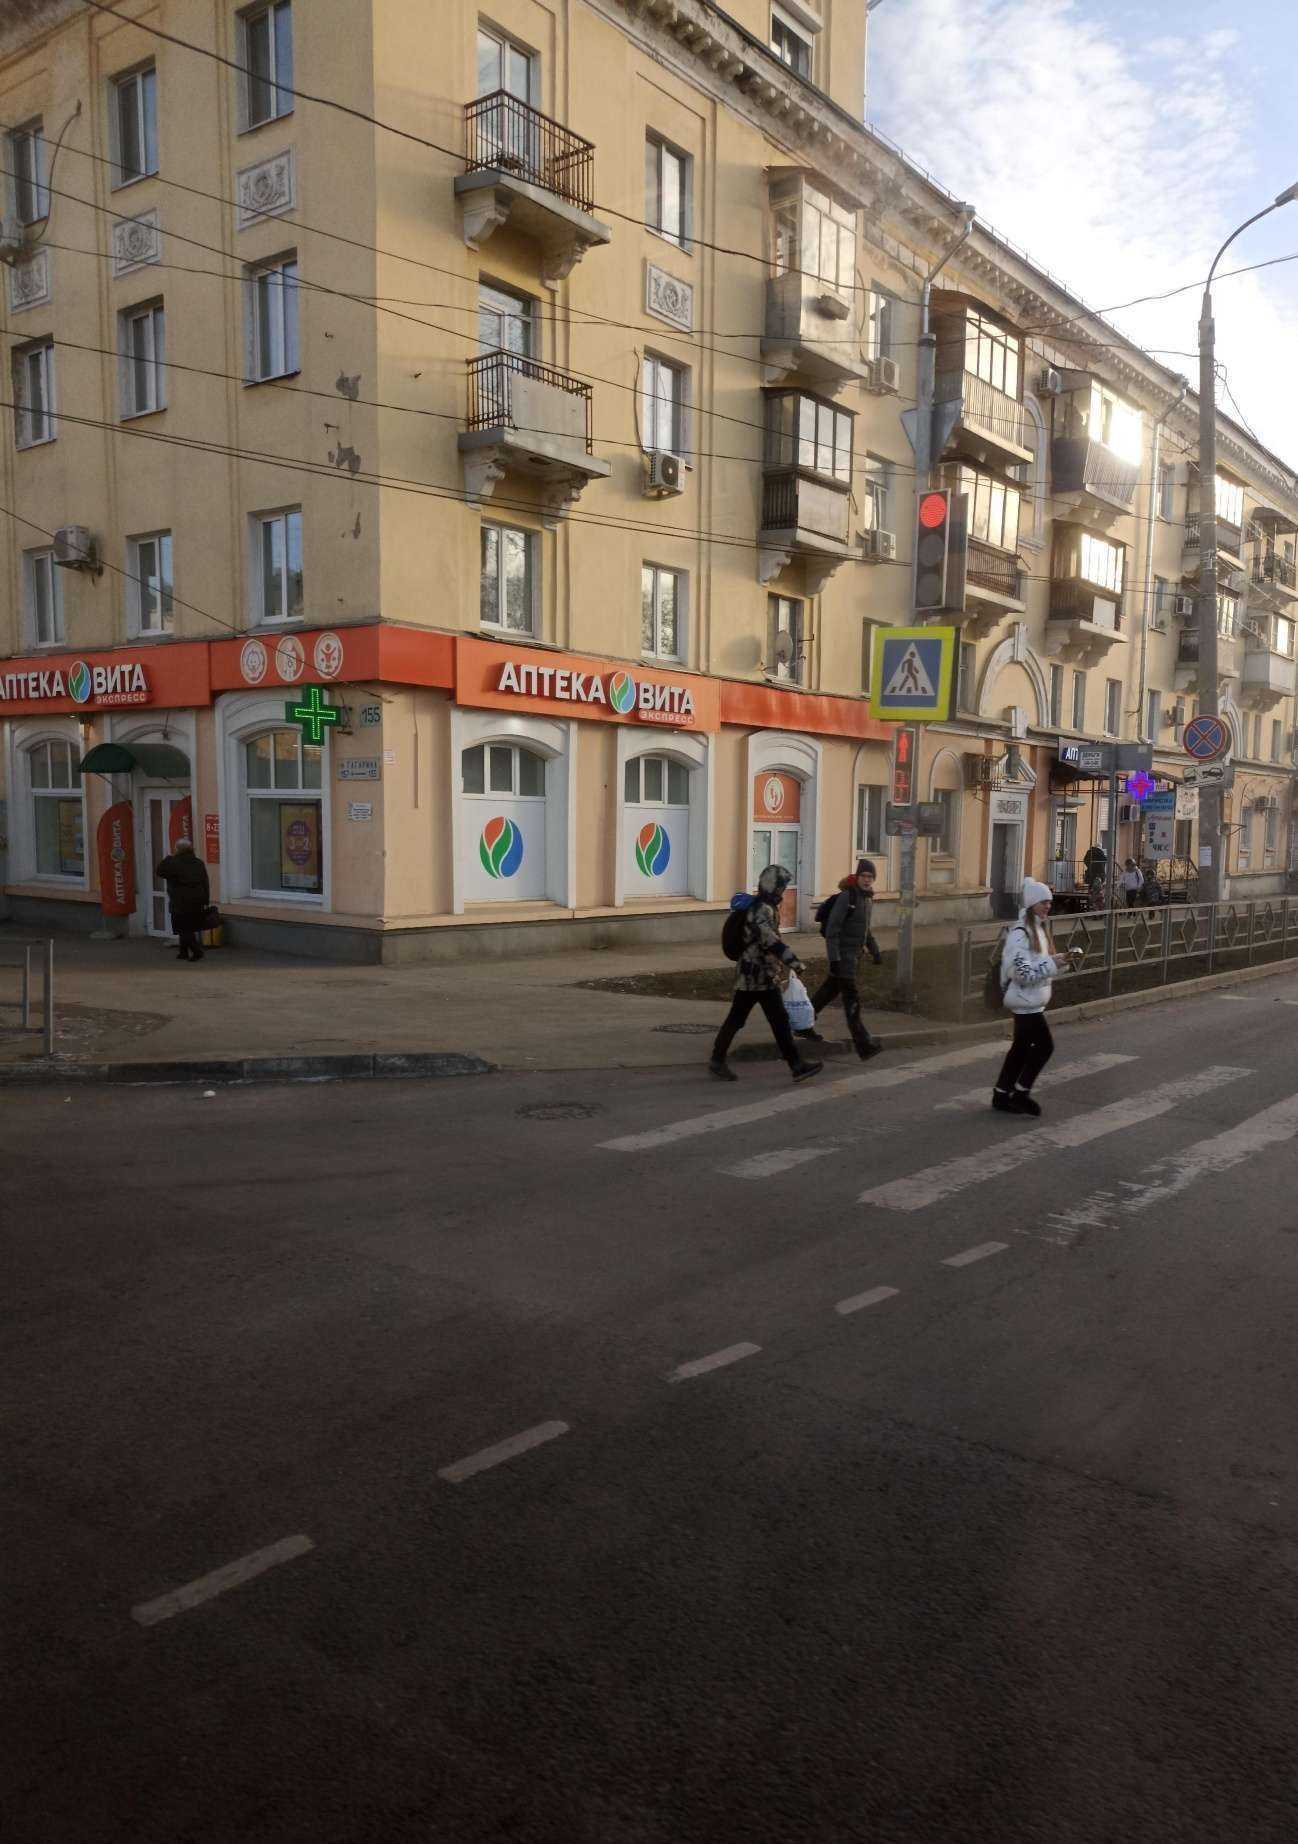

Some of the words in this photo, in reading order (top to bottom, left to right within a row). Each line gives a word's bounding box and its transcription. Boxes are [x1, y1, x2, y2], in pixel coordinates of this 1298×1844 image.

[92, 663, 147, 694] ВИТА
[498, 661, 607, 704] АПТЕКА
[639, 682, 695, 714] ВИТА
[95, 693, 146, 704] ЭКСПРЕСС
[361, 706, 381, 723] 155
[639, 710, 694, 724] ЭКСПРЕСС
